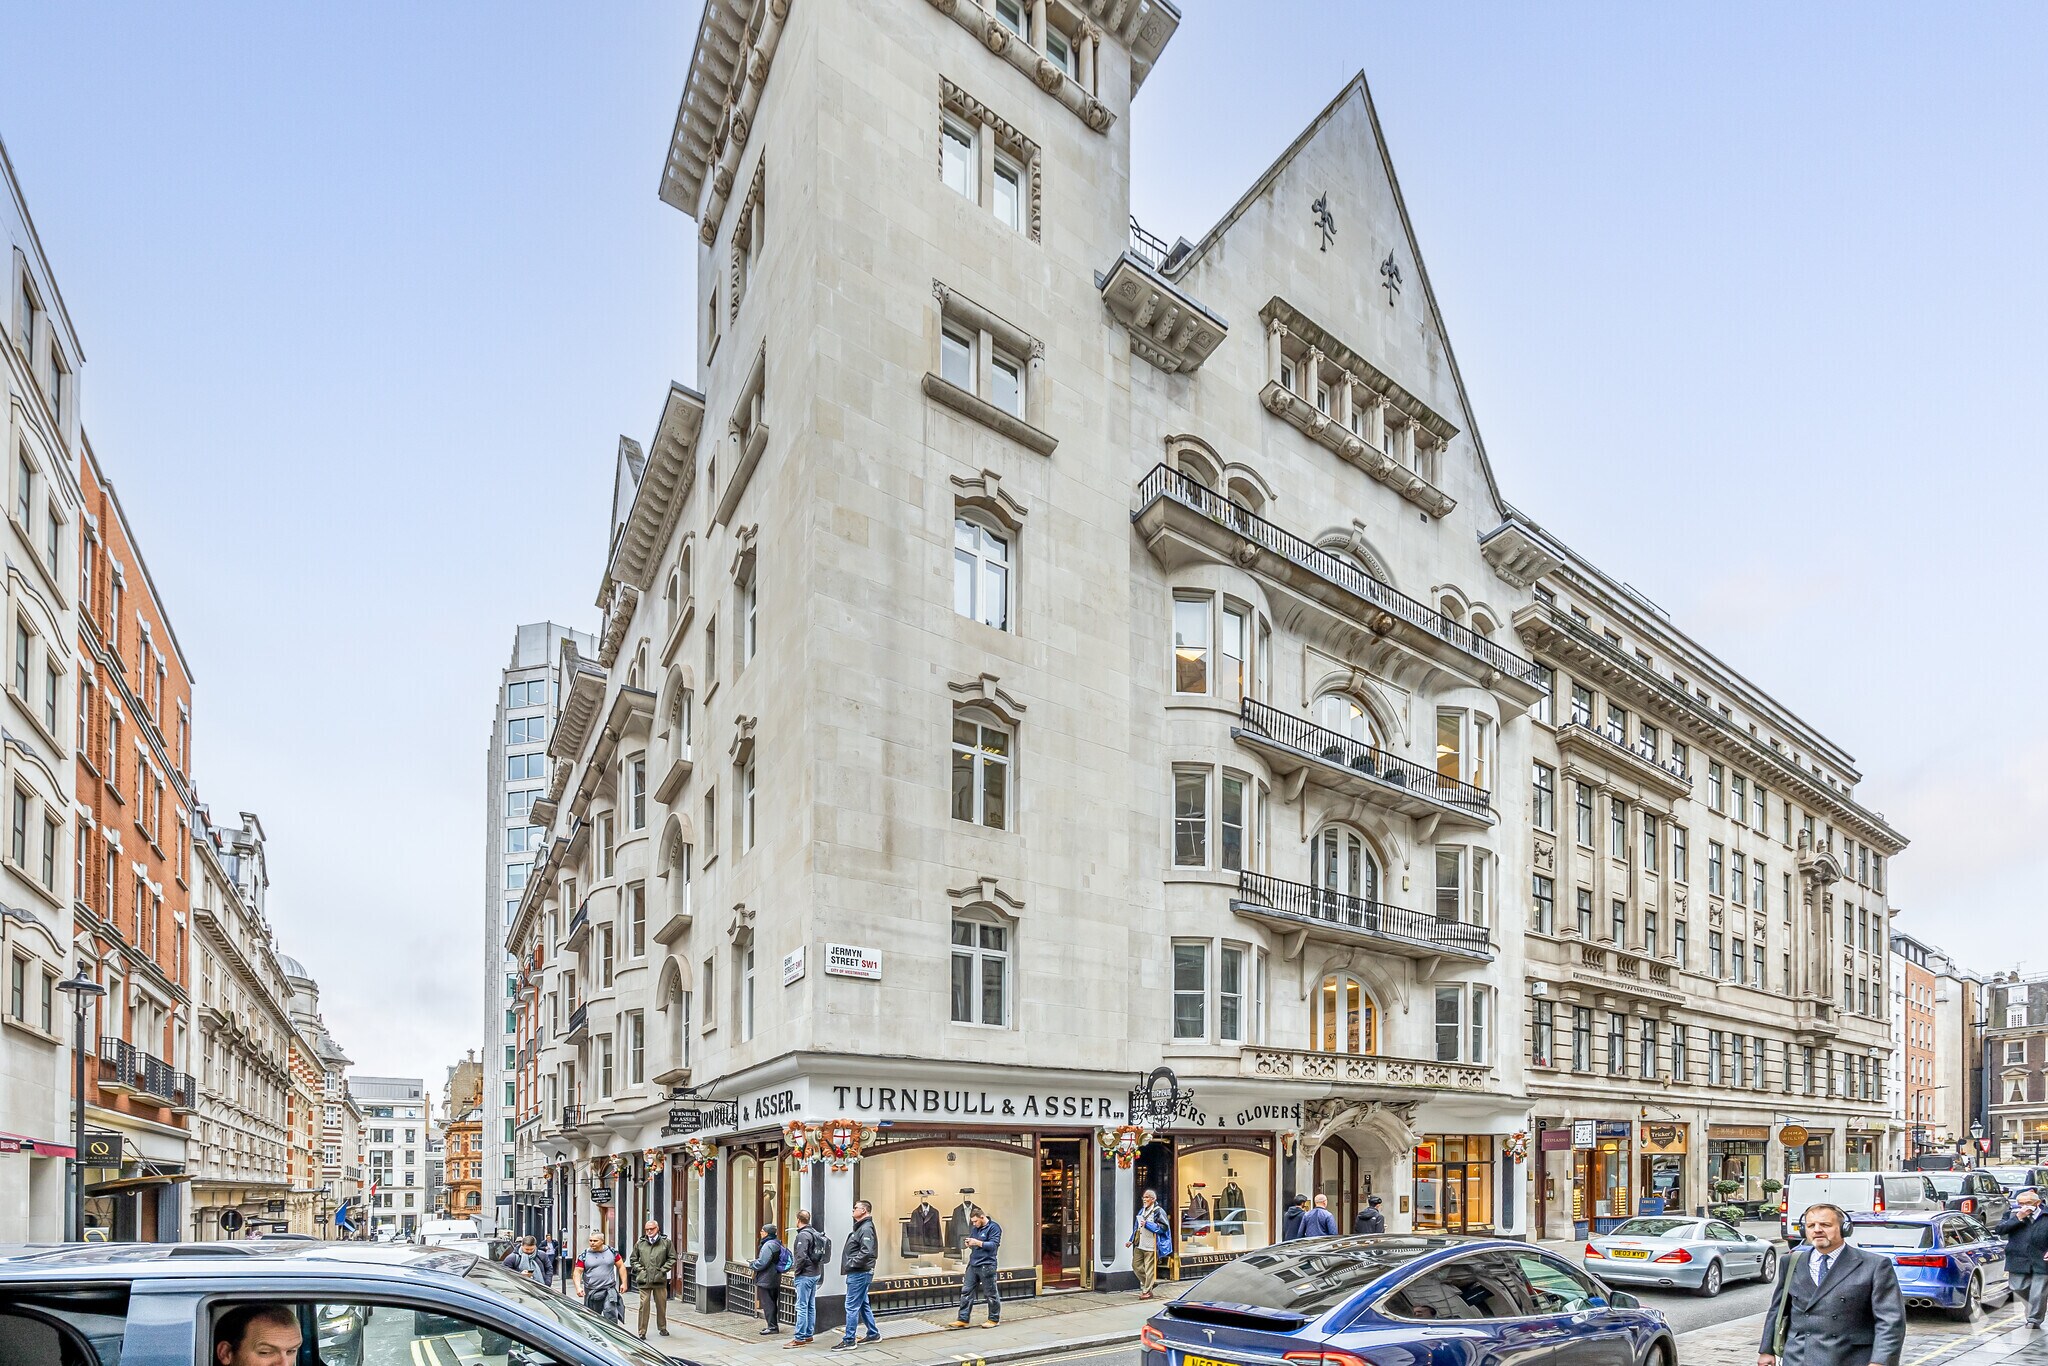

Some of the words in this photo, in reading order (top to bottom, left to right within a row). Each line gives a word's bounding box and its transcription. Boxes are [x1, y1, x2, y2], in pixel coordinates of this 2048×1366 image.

[830, 946, 862, 958] JERMYN
[830, 956, 859, 967] STREET
[861, 960, 878, 970] SW1
[743, 1106, 750, 1121] &
[755, 1089, 794, 1119] ASSER
[833, 1086, 995, 1114] TURNBULL
[1001, 1098, 1016, 1116] &
[1023, 1095, 1113, 1118] ASSER
[1218, 1116, 1226, 1127] &
[1237, 1105, 1299, 1126] GLOVERS
[1193, 1255, 1233, 1264] TURNBULL
[885, 1276, 954, 1290] TURNBULL
